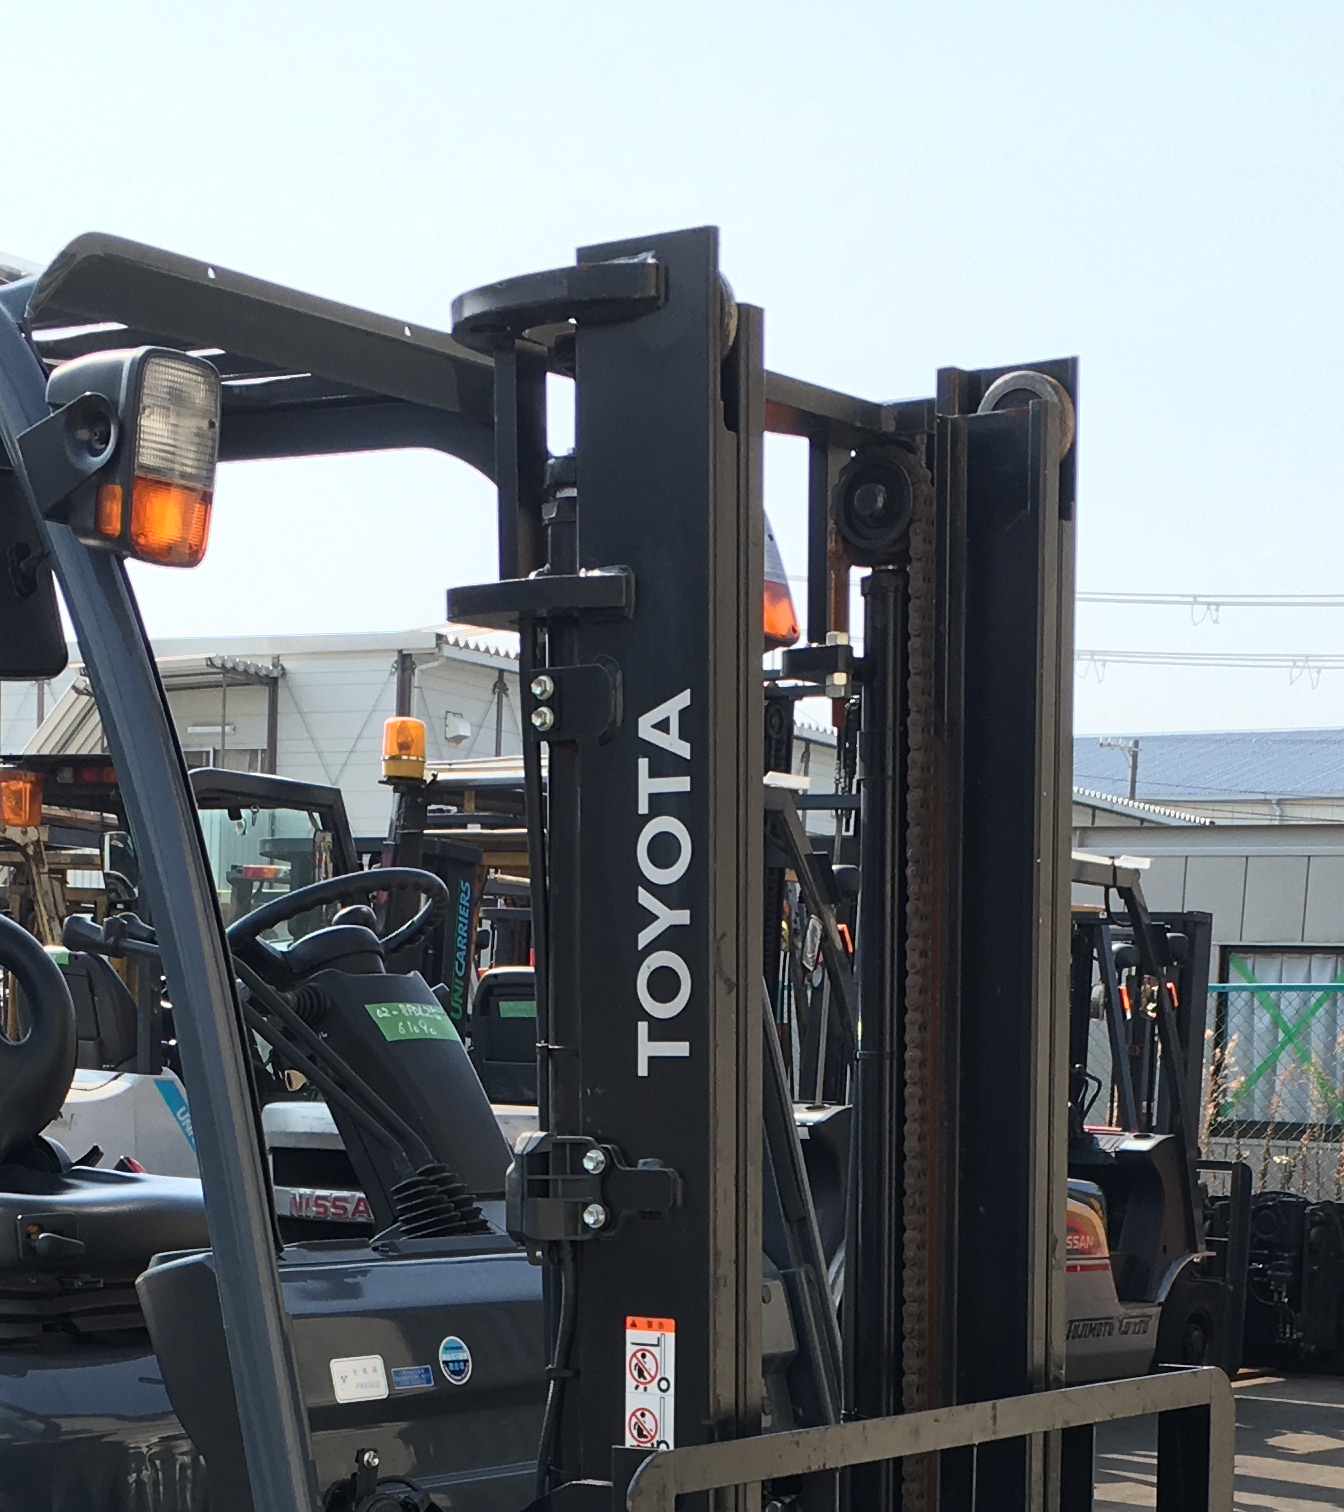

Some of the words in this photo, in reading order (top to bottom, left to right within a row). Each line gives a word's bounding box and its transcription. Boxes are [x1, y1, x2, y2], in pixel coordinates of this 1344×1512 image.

[636, 688, 692, 1077] TOYOTA
[455, 880, 471, 977] CARRIERS
[451, 979, 464, 1020] UNI
[288, 1192, 374, 1220] NISSA
